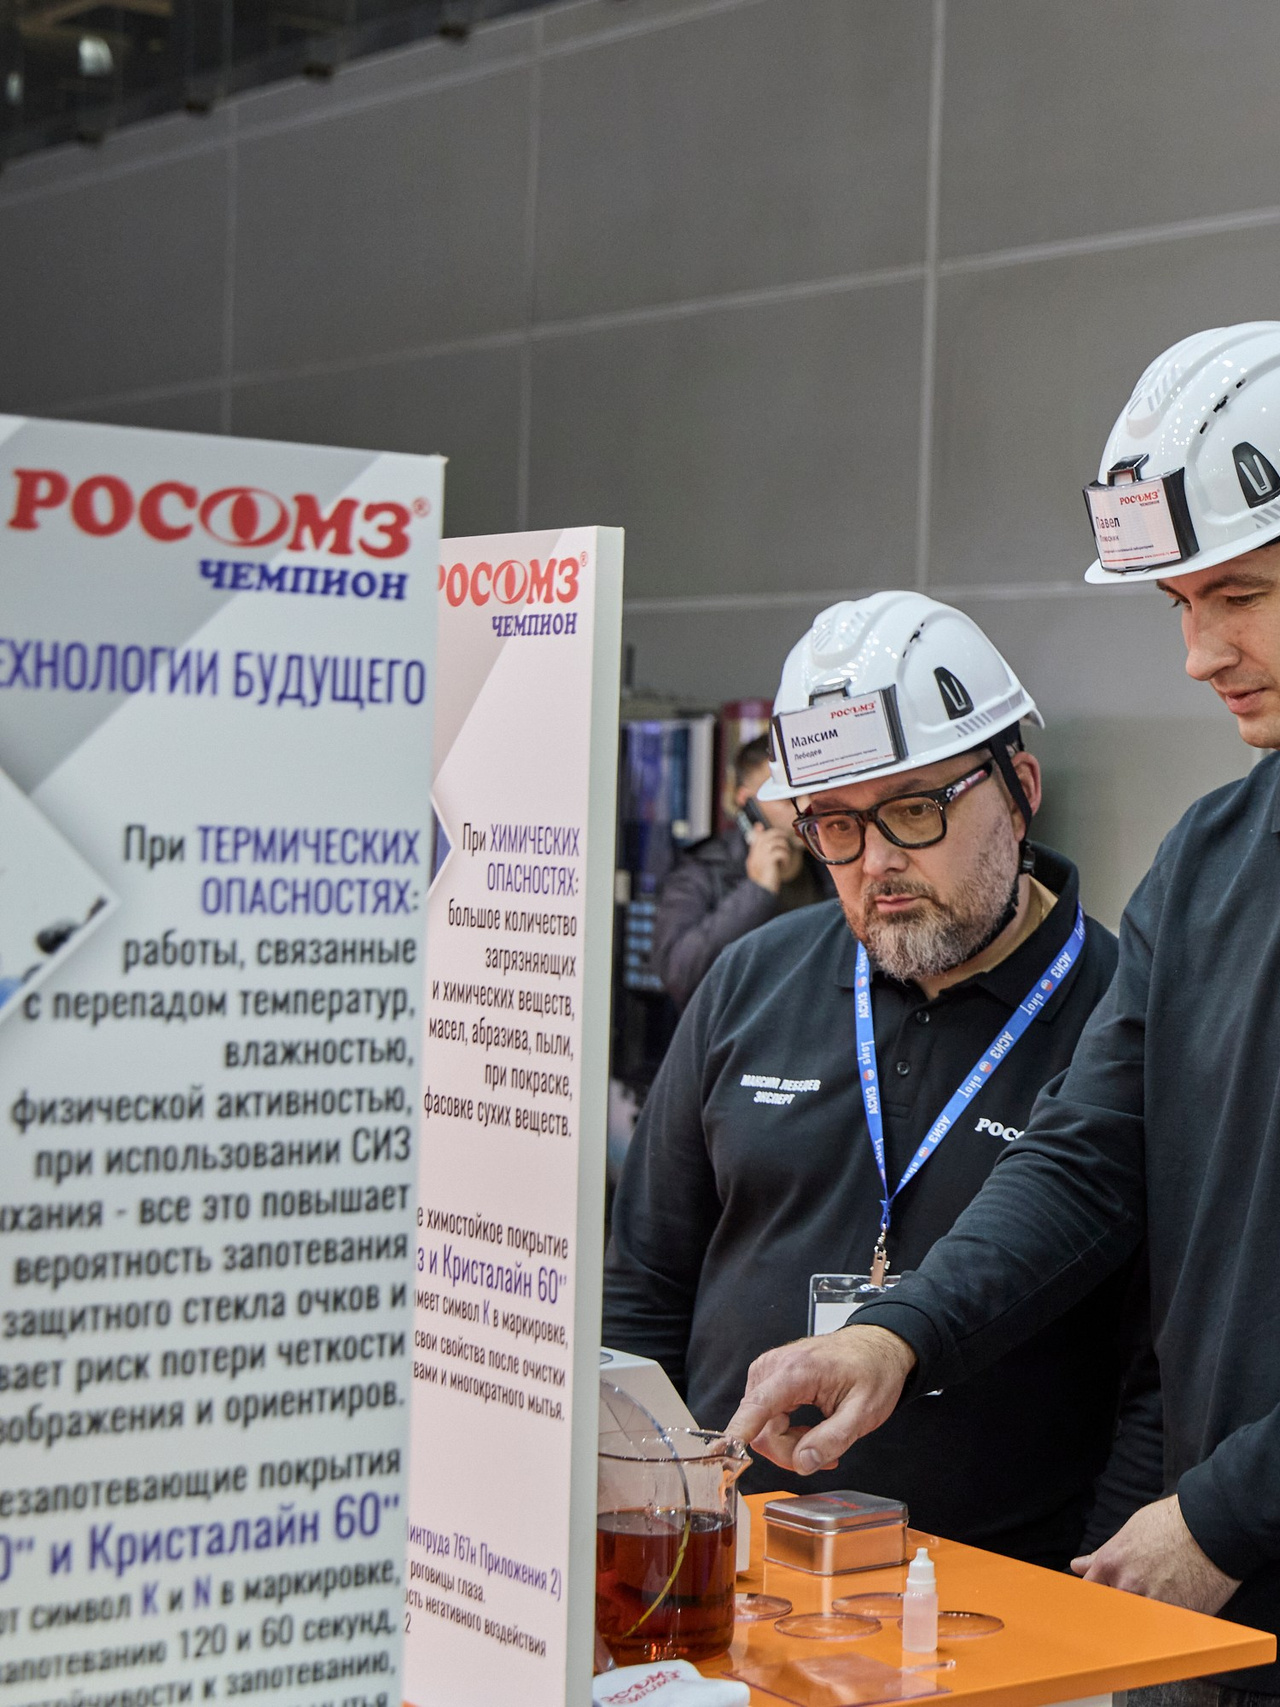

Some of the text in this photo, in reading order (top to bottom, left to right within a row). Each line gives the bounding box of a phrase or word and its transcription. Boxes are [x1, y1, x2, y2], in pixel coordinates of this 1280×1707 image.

[199, 559, 409, 600] ЧЕМПИОН
[492, 612, 577, 637] ЧЕМПИОН
[234, 649, 426, 709] БУДУЩЕГО
[791, 728, 839, 749] Максим
[123, 824, 420, 869] При ТЕРМИЧЕСКИХ
[462, 823, 580, 857] При ХИМИЧЕСКИХ
[201, 876, 419, 916] ОПАСНОСТЯХ:
[487, 862, 579, 897] ОПАСНОСТЯХ:
[448, 898, 577, 937] большое количество
[123, 929, 416, 971] работы, связанные
[485, 947, 576, 979] загрязняющих
[1050, 951, 1072, 979] АСИЗ
[23, 985, 416, 1026] с перепадом температур,
[432, 980, 575, 1021] и химических веществ,
[225, 1036, 414, 1068] влажностью,
[429, 1016, 574, 1061] масел, абразива, пыли,
[989, 1030, 1014, 1060] АСИЗ
[485, 1063, 573, 1102] при покраске,
[865, 1085, 879, 1115] АСИЗ
[12, 1084, 412, 1133] физической активностью,
[423, 1086, 572, 1138] фасовке сухих веществ.
[928, 1115, 951, 1144] АСИЗ
[36, 1126, 411, 1185] при использовании СИЗ
[139, 1196, 190, 1225] все
[203, 1192, 249, 1221] это
[262, 1182, 410, 1215] повышает
[427, 1208, 503, 1245] химостойкое
[507, 1226, 569, 1259] покрытие
[14, 1232, 408, 1290] вероятность запотевания
[429, 1250, 438, 1275] и
[443, 1244, 532, 1299] Кристалайн
[4, 1284, 407, 1341] защитного стекла очков и
[442, 1296, 480, 1323] символ
[493, 1309, 499, 1327] в
[502, 1311, 569, 1350] маркировке,
[76, 1349, 150, 1394] риск
[161, 1338, 266, 1385] потери
[277, 1330, 405, 1368] четкости
[415, 1330, 565, 1387] свои свойства после очистки
[197, 1398, 213, 1424] и
[225, 1382, 404, 1428] ориентиров.
[441, 1369, 447, 1386] и
[450, 1372, 525, 1409] многократного
[527, 1393, 565, 1421] мытья.
[258, 1448, 400, 1490] покрытия
[51, 1541, 71, 1575] и
[90, 1502, 319, 1577] Кристалайн
[407, 1517, 562, 1602] интруда 767н Приложения 2)
[31, 1594, 131, 1630] символ
[169, 1588, 183, 1612] и
[220, 1579, 234, 1605] в
[243, 1559, 400, 1604] маркировке,
[410, 1560, 486, 1603] роговицы глаза.
[0, 1641, 166, 1684] апотеванию
[180, 1623, 227, 1661] 120
[236, 1630, 250, 1651] и
[261, 1614, 293, 1648] 60
[425, 1595, 482, 1632] негативного
[484, 1618, 546, 1658] воздействия
[203, 1678, 216, 1699] к
[226, 1650, 396, 1696] запотеванию,
